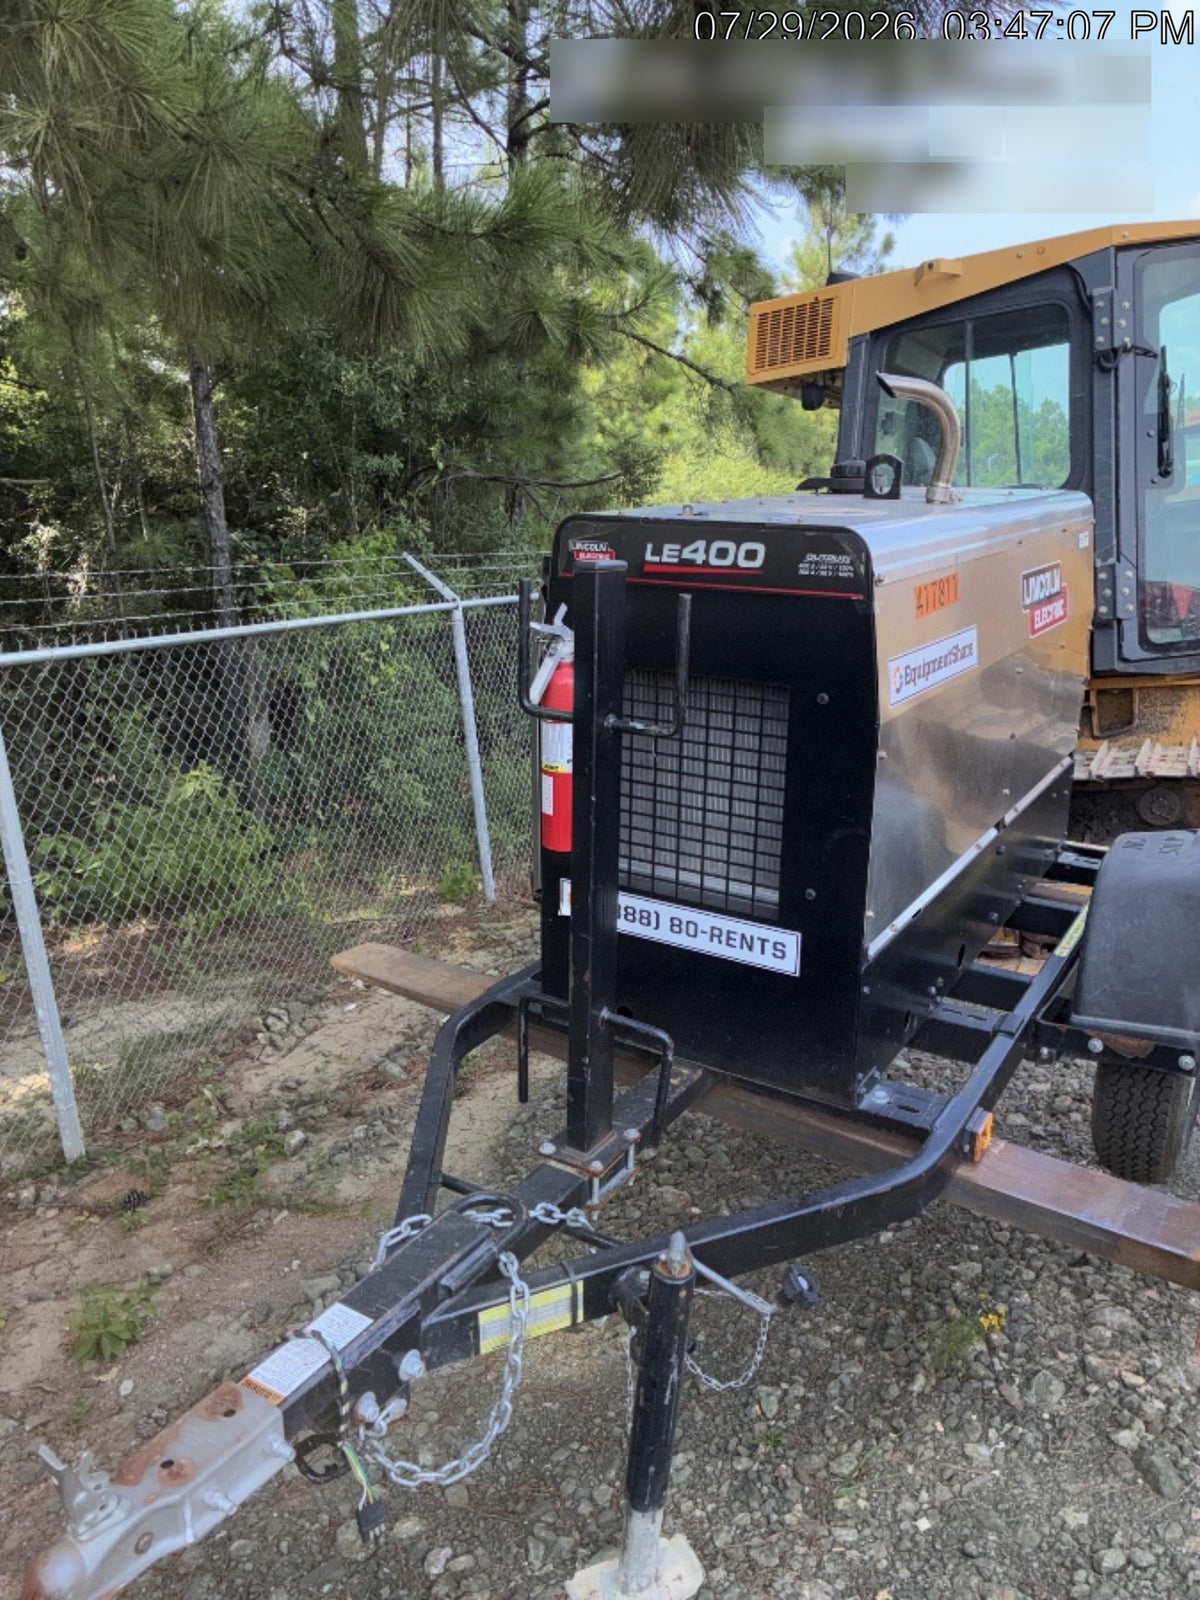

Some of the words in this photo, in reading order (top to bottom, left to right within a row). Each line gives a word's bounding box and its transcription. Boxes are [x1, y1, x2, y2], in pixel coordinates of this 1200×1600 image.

[644, 540, 766, 568] LE400
[1023, 568, 1061, 606] LINCOLN
[1034, 598, 1065, 630] ELECTRIC
[904, 642, 974, 687] EquipmentShare
[618, 904, 661, 931] 88)
[669, 916, 787, 960] 80-RENTS
